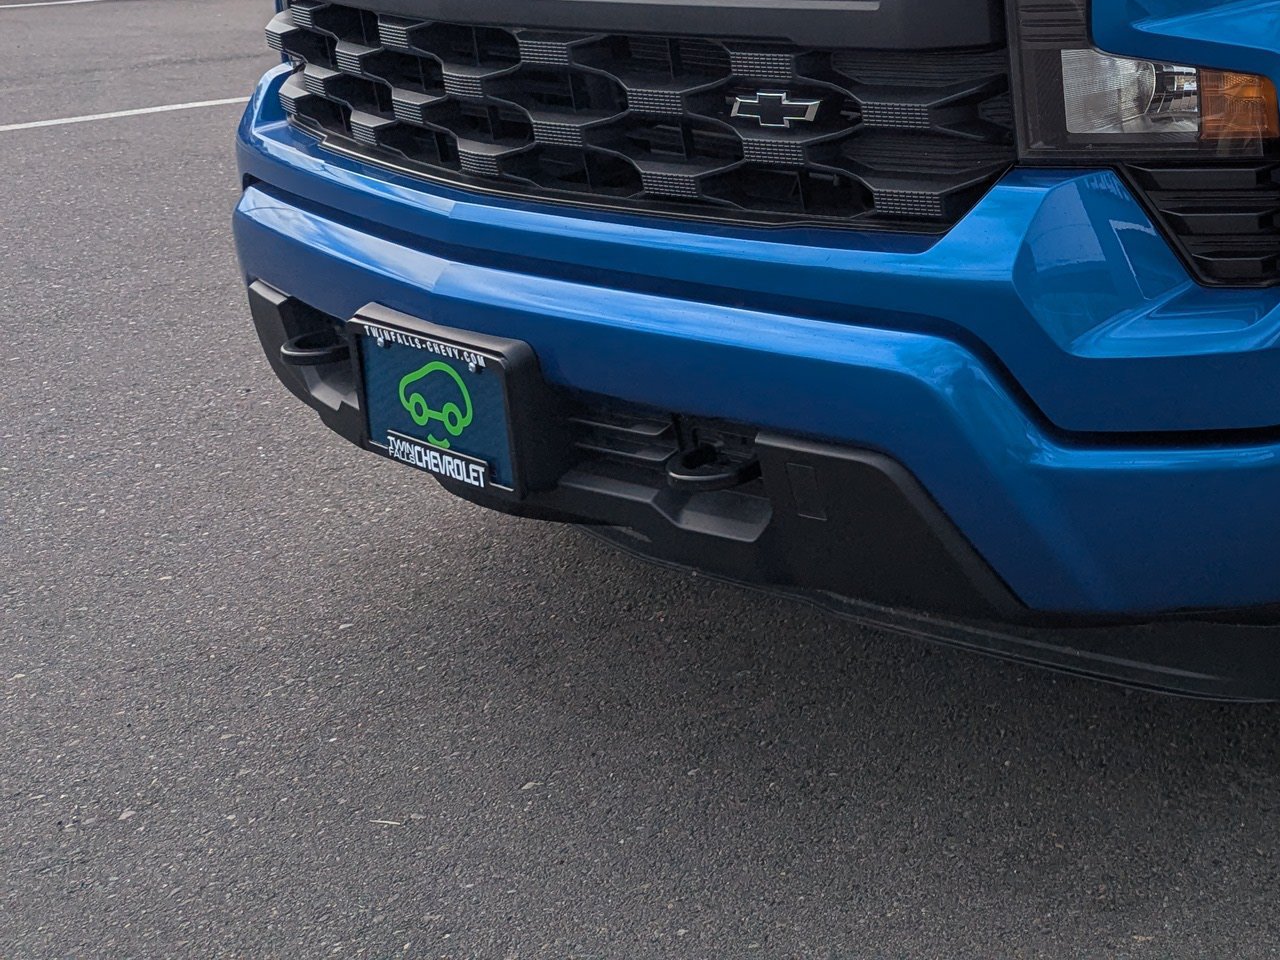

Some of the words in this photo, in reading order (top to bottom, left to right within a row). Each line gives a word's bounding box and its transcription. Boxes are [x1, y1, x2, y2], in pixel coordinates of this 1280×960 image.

[363, 325, 487, 368] TWINFALLS-CHEVY.COM
[387, 436, 415, 453] TWIN
[414, 446, 486, 488] CHEVROLET
[389, 448, 415, 466] FALLS
